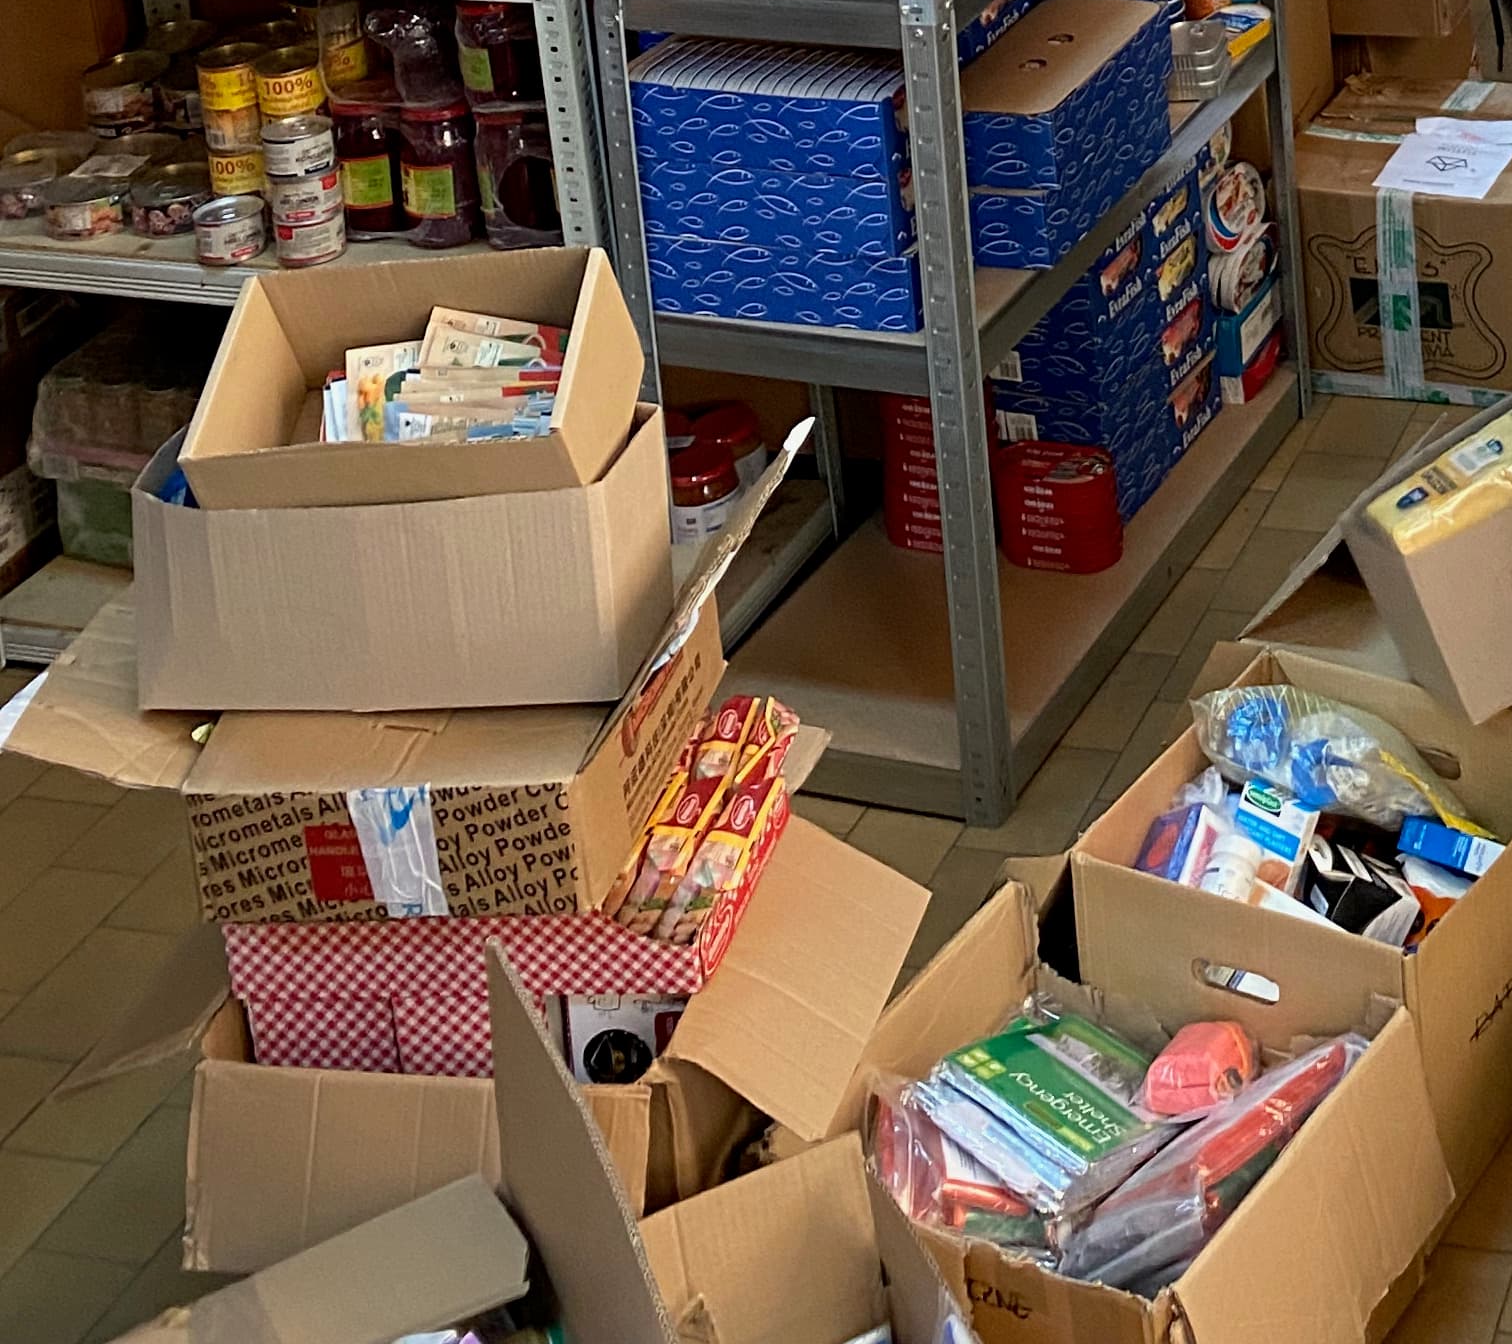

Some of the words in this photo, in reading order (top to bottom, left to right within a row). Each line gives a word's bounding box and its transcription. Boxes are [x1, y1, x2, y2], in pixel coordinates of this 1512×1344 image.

[264, 75, 314, 97] 100%
[435, 788, 518, 828] Powder
[464, 804, 548, 843] Powder
[438, 847, 491, 875] Alloy
[465, 863, 518, 893] Alloy
[494, 878, 548, 908] Alloy
[1009, 1071, 1111, 1144] Emergency
[1062, 1092, 1127, 1137] Shelter
